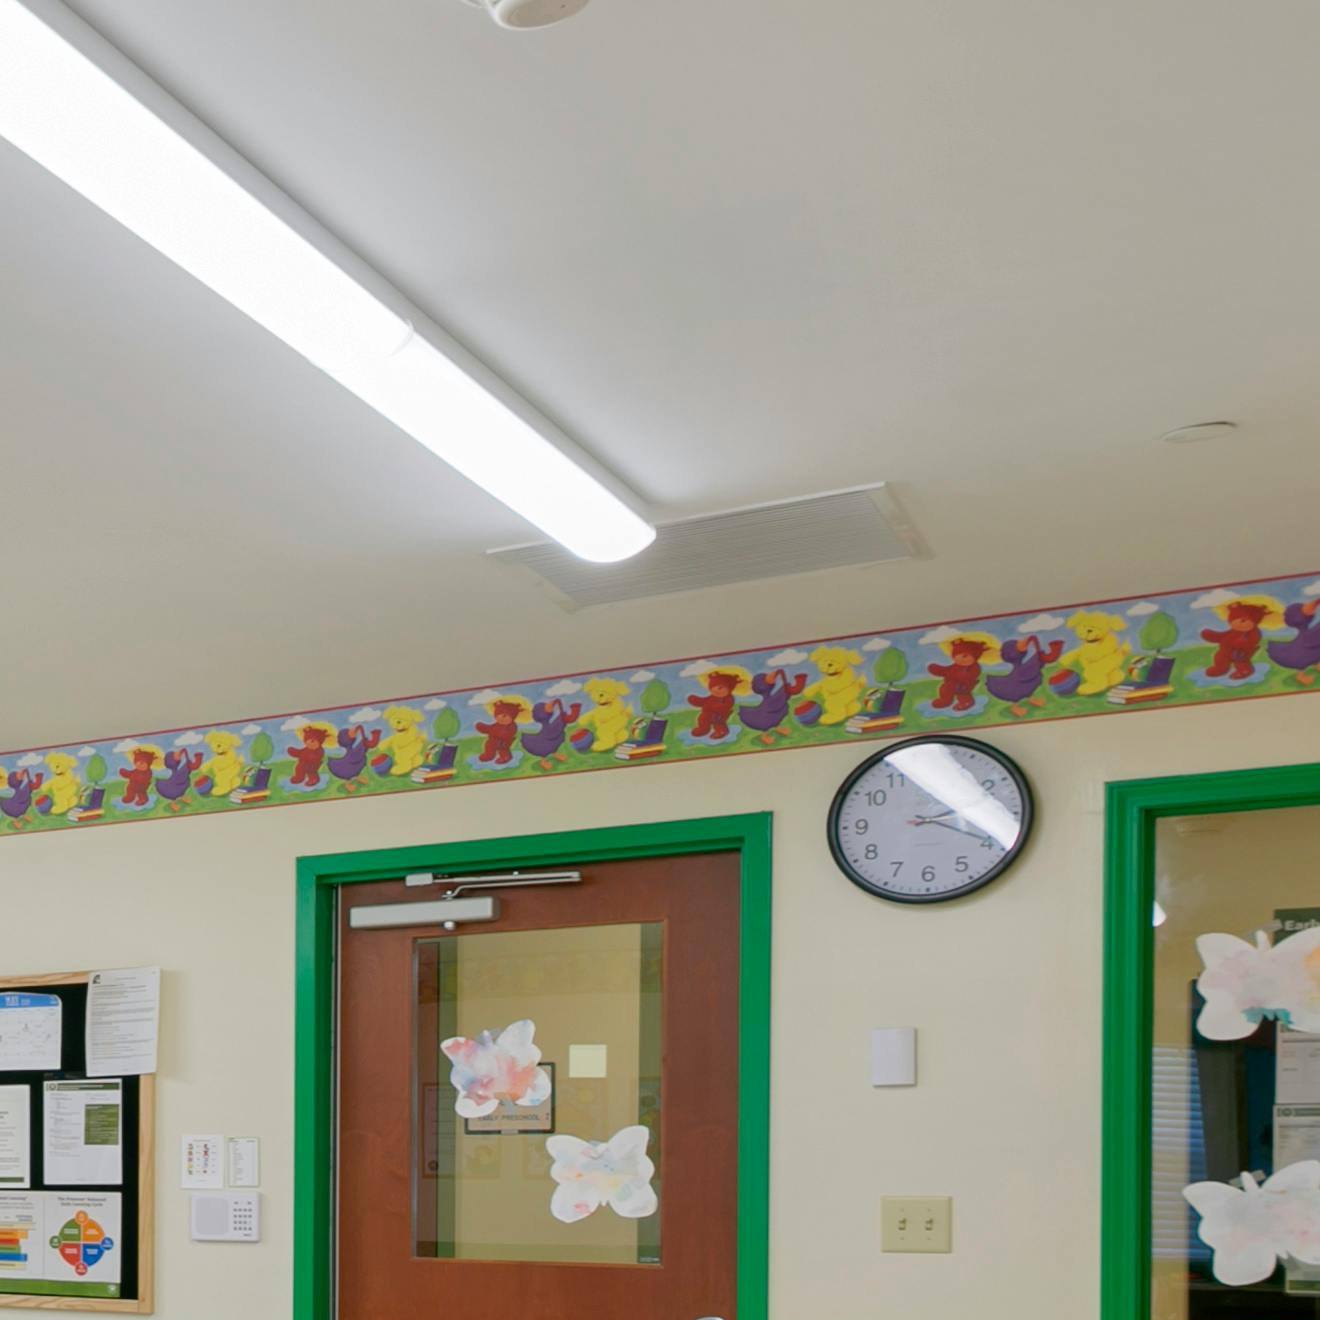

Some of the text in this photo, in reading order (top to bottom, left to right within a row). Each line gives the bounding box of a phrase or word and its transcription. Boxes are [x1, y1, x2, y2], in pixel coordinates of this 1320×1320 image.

[886, 773, 906, 788] 11
[864, 789, 887, 806] 10
[855, 818, 869, 836] 9
[864, 843, 879, 861] 8
[889, 861, 904, 878] 7
[954, 855, 969, 873] 5
[921, 865, 936, 883] 6
